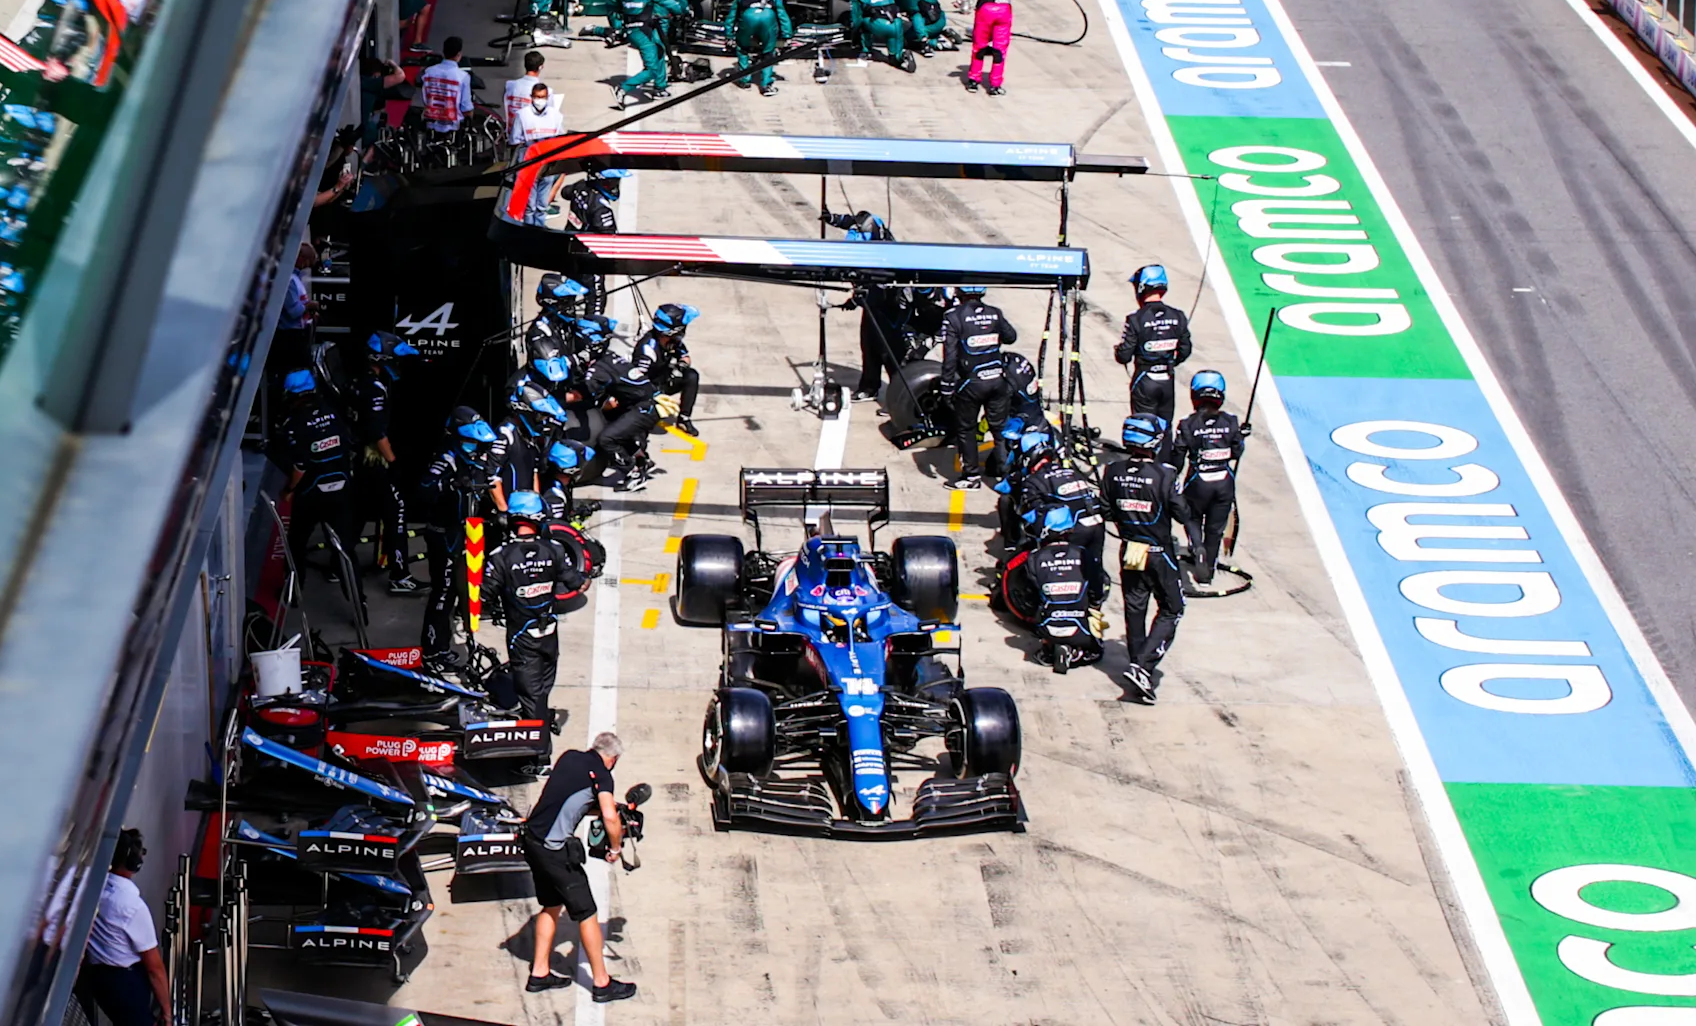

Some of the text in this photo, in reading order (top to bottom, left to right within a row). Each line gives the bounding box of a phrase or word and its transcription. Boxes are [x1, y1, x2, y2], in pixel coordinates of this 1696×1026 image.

[1208, 145, 1412, 336] aramco
[1016, 254, 1074, 263] ALPINE
[408, 339, 460, 348] LPINE
[752, 472, 879, 485] ALPINE
[1122, 500, 1149, 511] Castrol
[511, 559, 553, 570] ALPINE
[1041, 560, 1081, 568] ALPINE
[1330, 420, 1612, 714] aramco
[436, 557, 453, 610] ALPINE
[1051, 584, 1077, 593] Castrol
[526, 583, 552, 596] Castrol
[471, 731, 540, 743] ALPINE
[377, 740, 400, 749] PLUG
[366, 748, 400, 756] POWER
[418, 753, 436, 761] WER
[307, 844, 394, 858] ALPINE
[463, 846, 524, 856] ALPI
[302, 938, 390, 951] ALPINE
